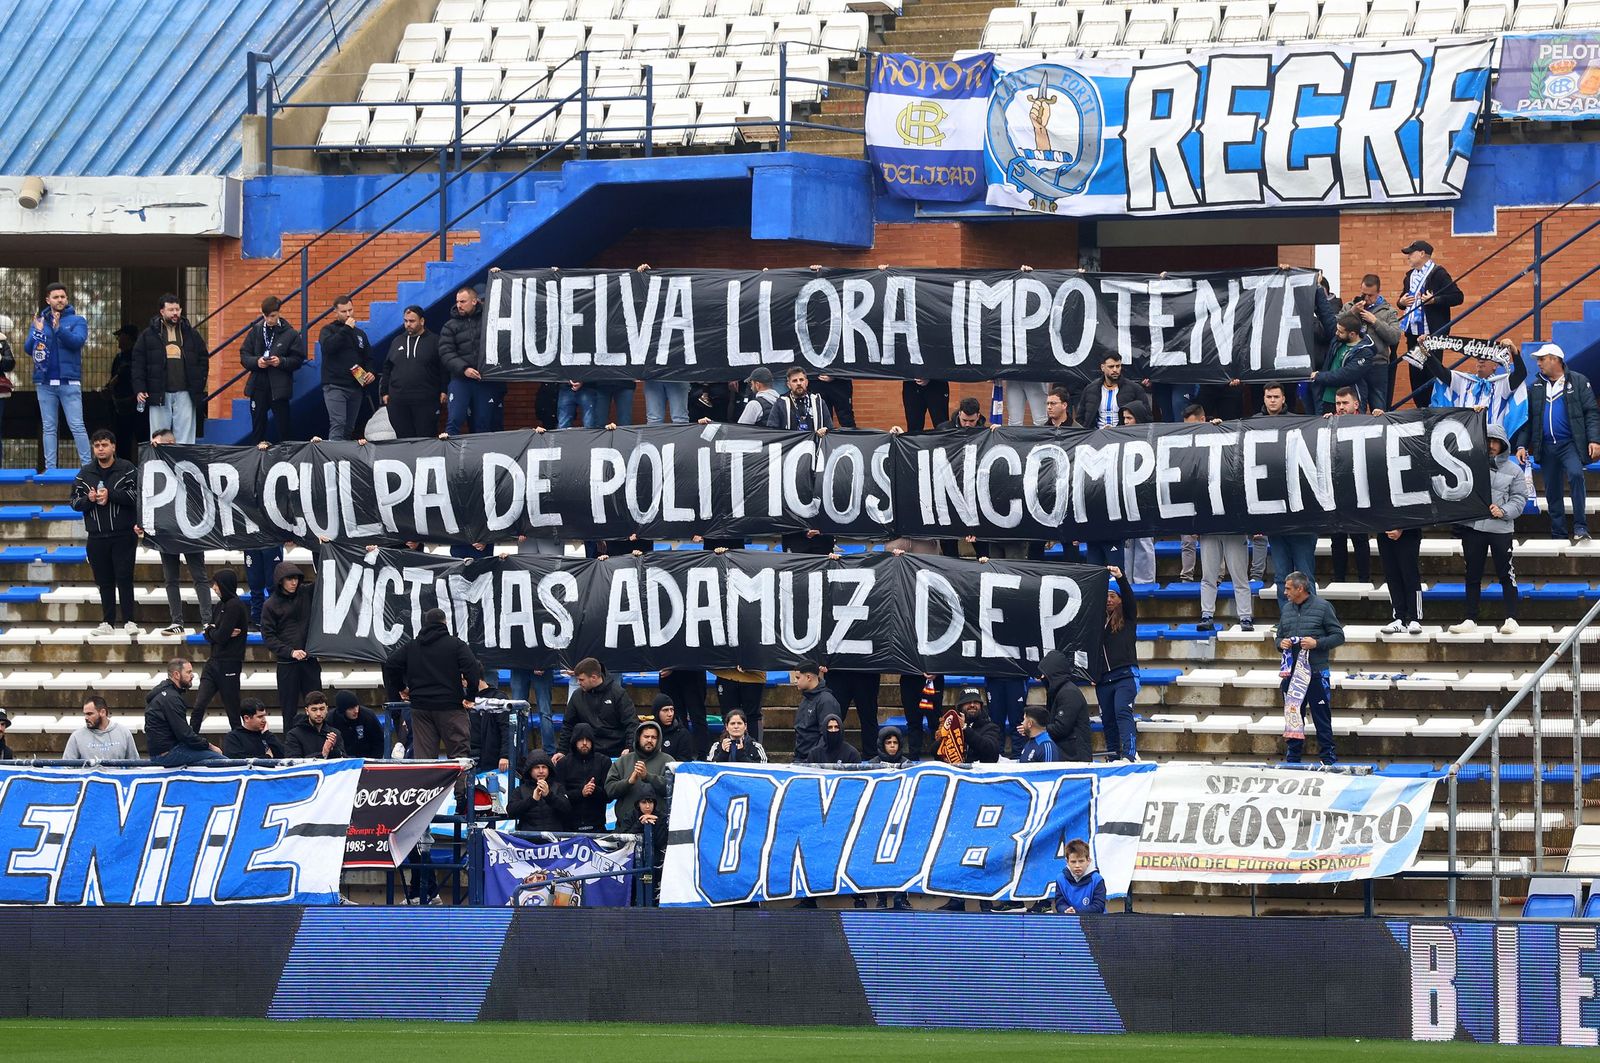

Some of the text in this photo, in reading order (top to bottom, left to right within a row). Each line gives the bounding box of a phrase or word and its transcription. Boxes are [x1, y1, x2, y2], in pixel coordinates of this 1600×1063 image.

[1059, 73, 1096, 116] FORTI
[1517, 97, 1600, 112] PANSAR
[486, 273, 1316, 370] HUELVA LLORA IMPOTENTE
[141, 417, 1474, 541] POR CULPA DE POLÍTICOS INCOMPETENTES
[322, 548, 1088, 669] VÍCTIMAS ADAMUZ D.E.P.
[1205, 774, 1325, 797] SECTOR
[0, 772, 324, 906] ENTE
[345, 840, 366, 852] 1985
[487, 844, 563, 866] BRIGADA
[695, 772, 1098, 906] ONUBA
[1141, 855, 1200, 869] DECANO
[1205, 856, 1232, 870] DEL
[1410, 925, 1599, 1046] BIE
